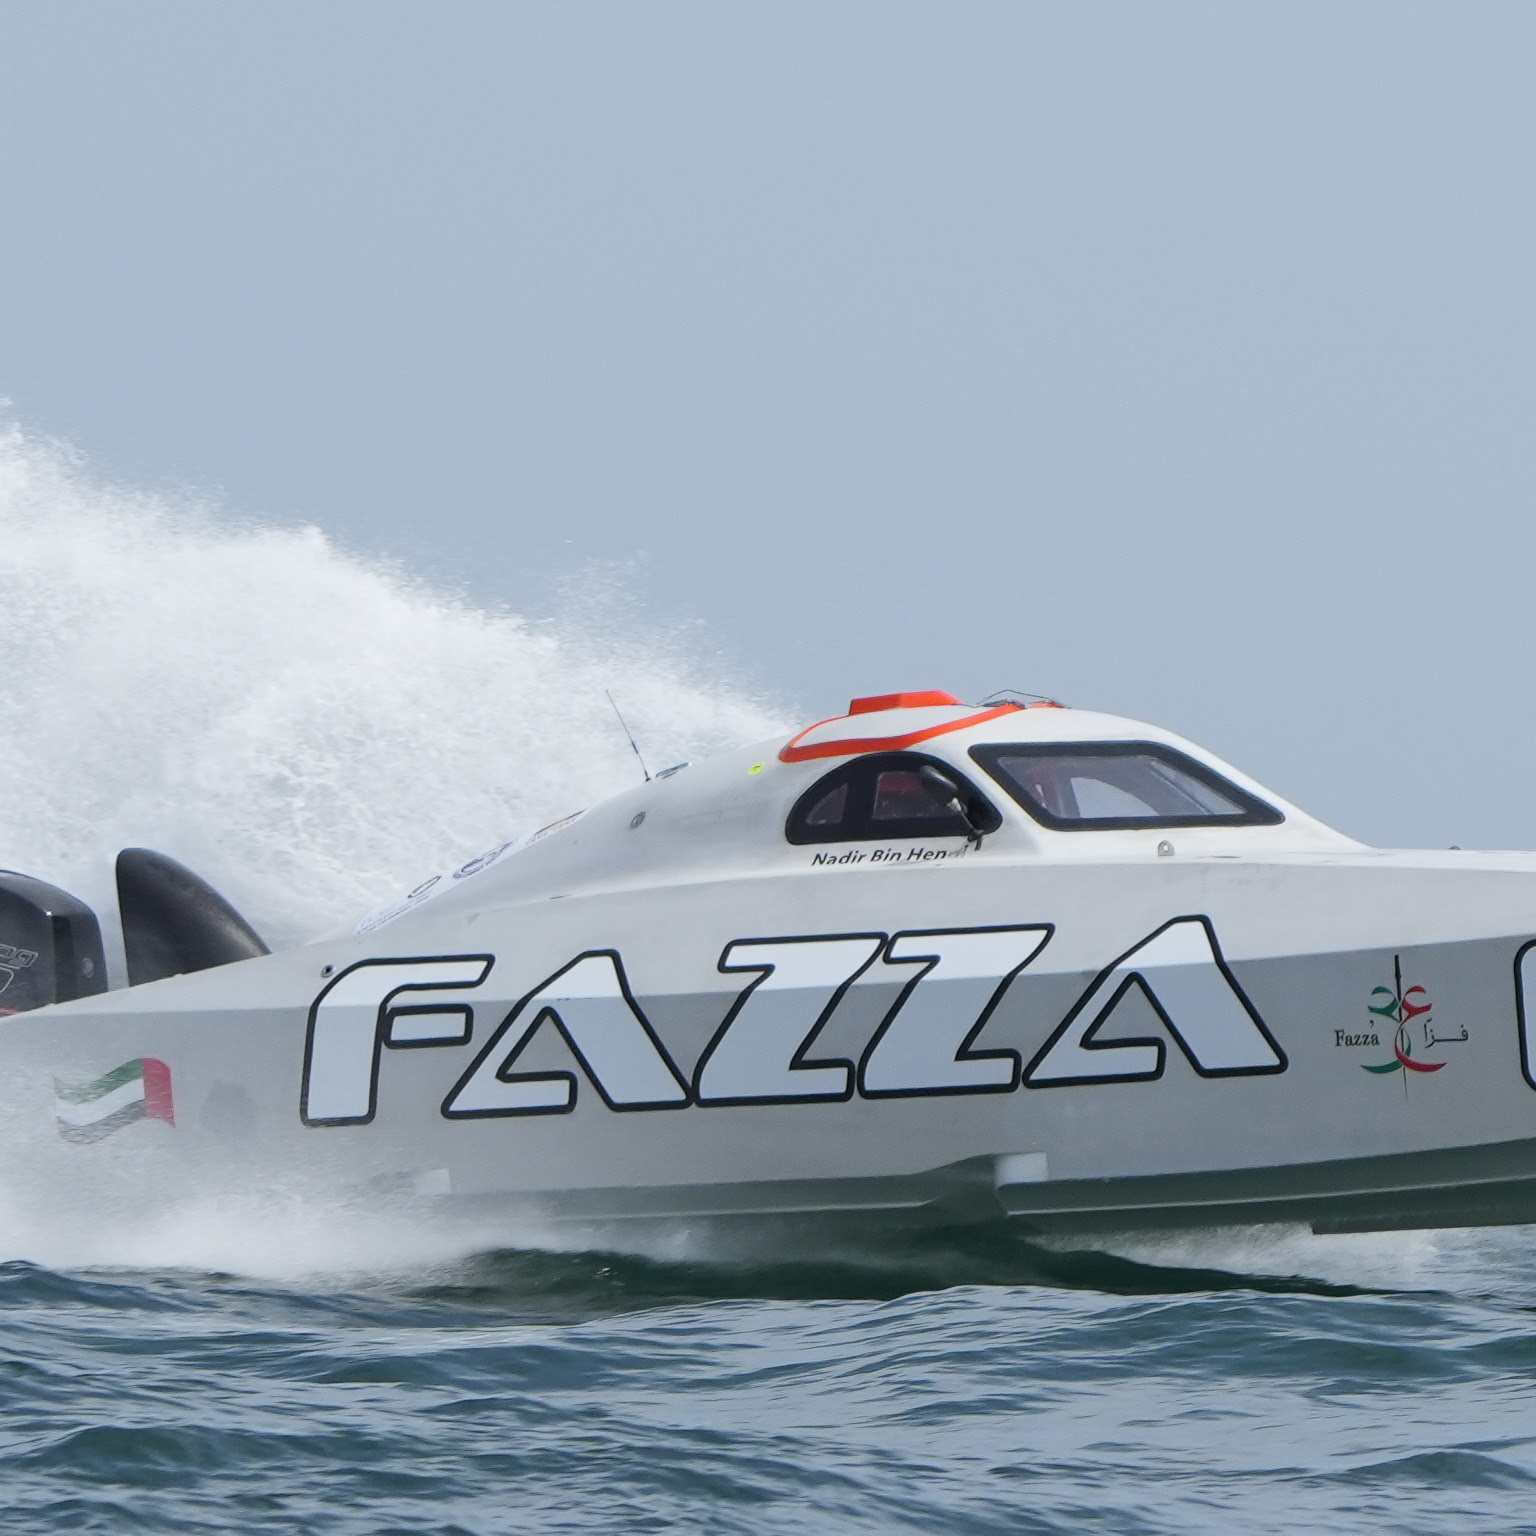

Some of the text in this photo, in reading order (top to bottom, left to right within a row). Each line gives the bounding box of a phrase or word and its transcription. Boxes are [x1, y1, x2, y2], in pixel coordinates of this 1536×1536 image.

[811, 849, 867, 866] Nadir
[870, 847, 902, 862] Bin
[300, 914, 1289, 1127] FAZZA
